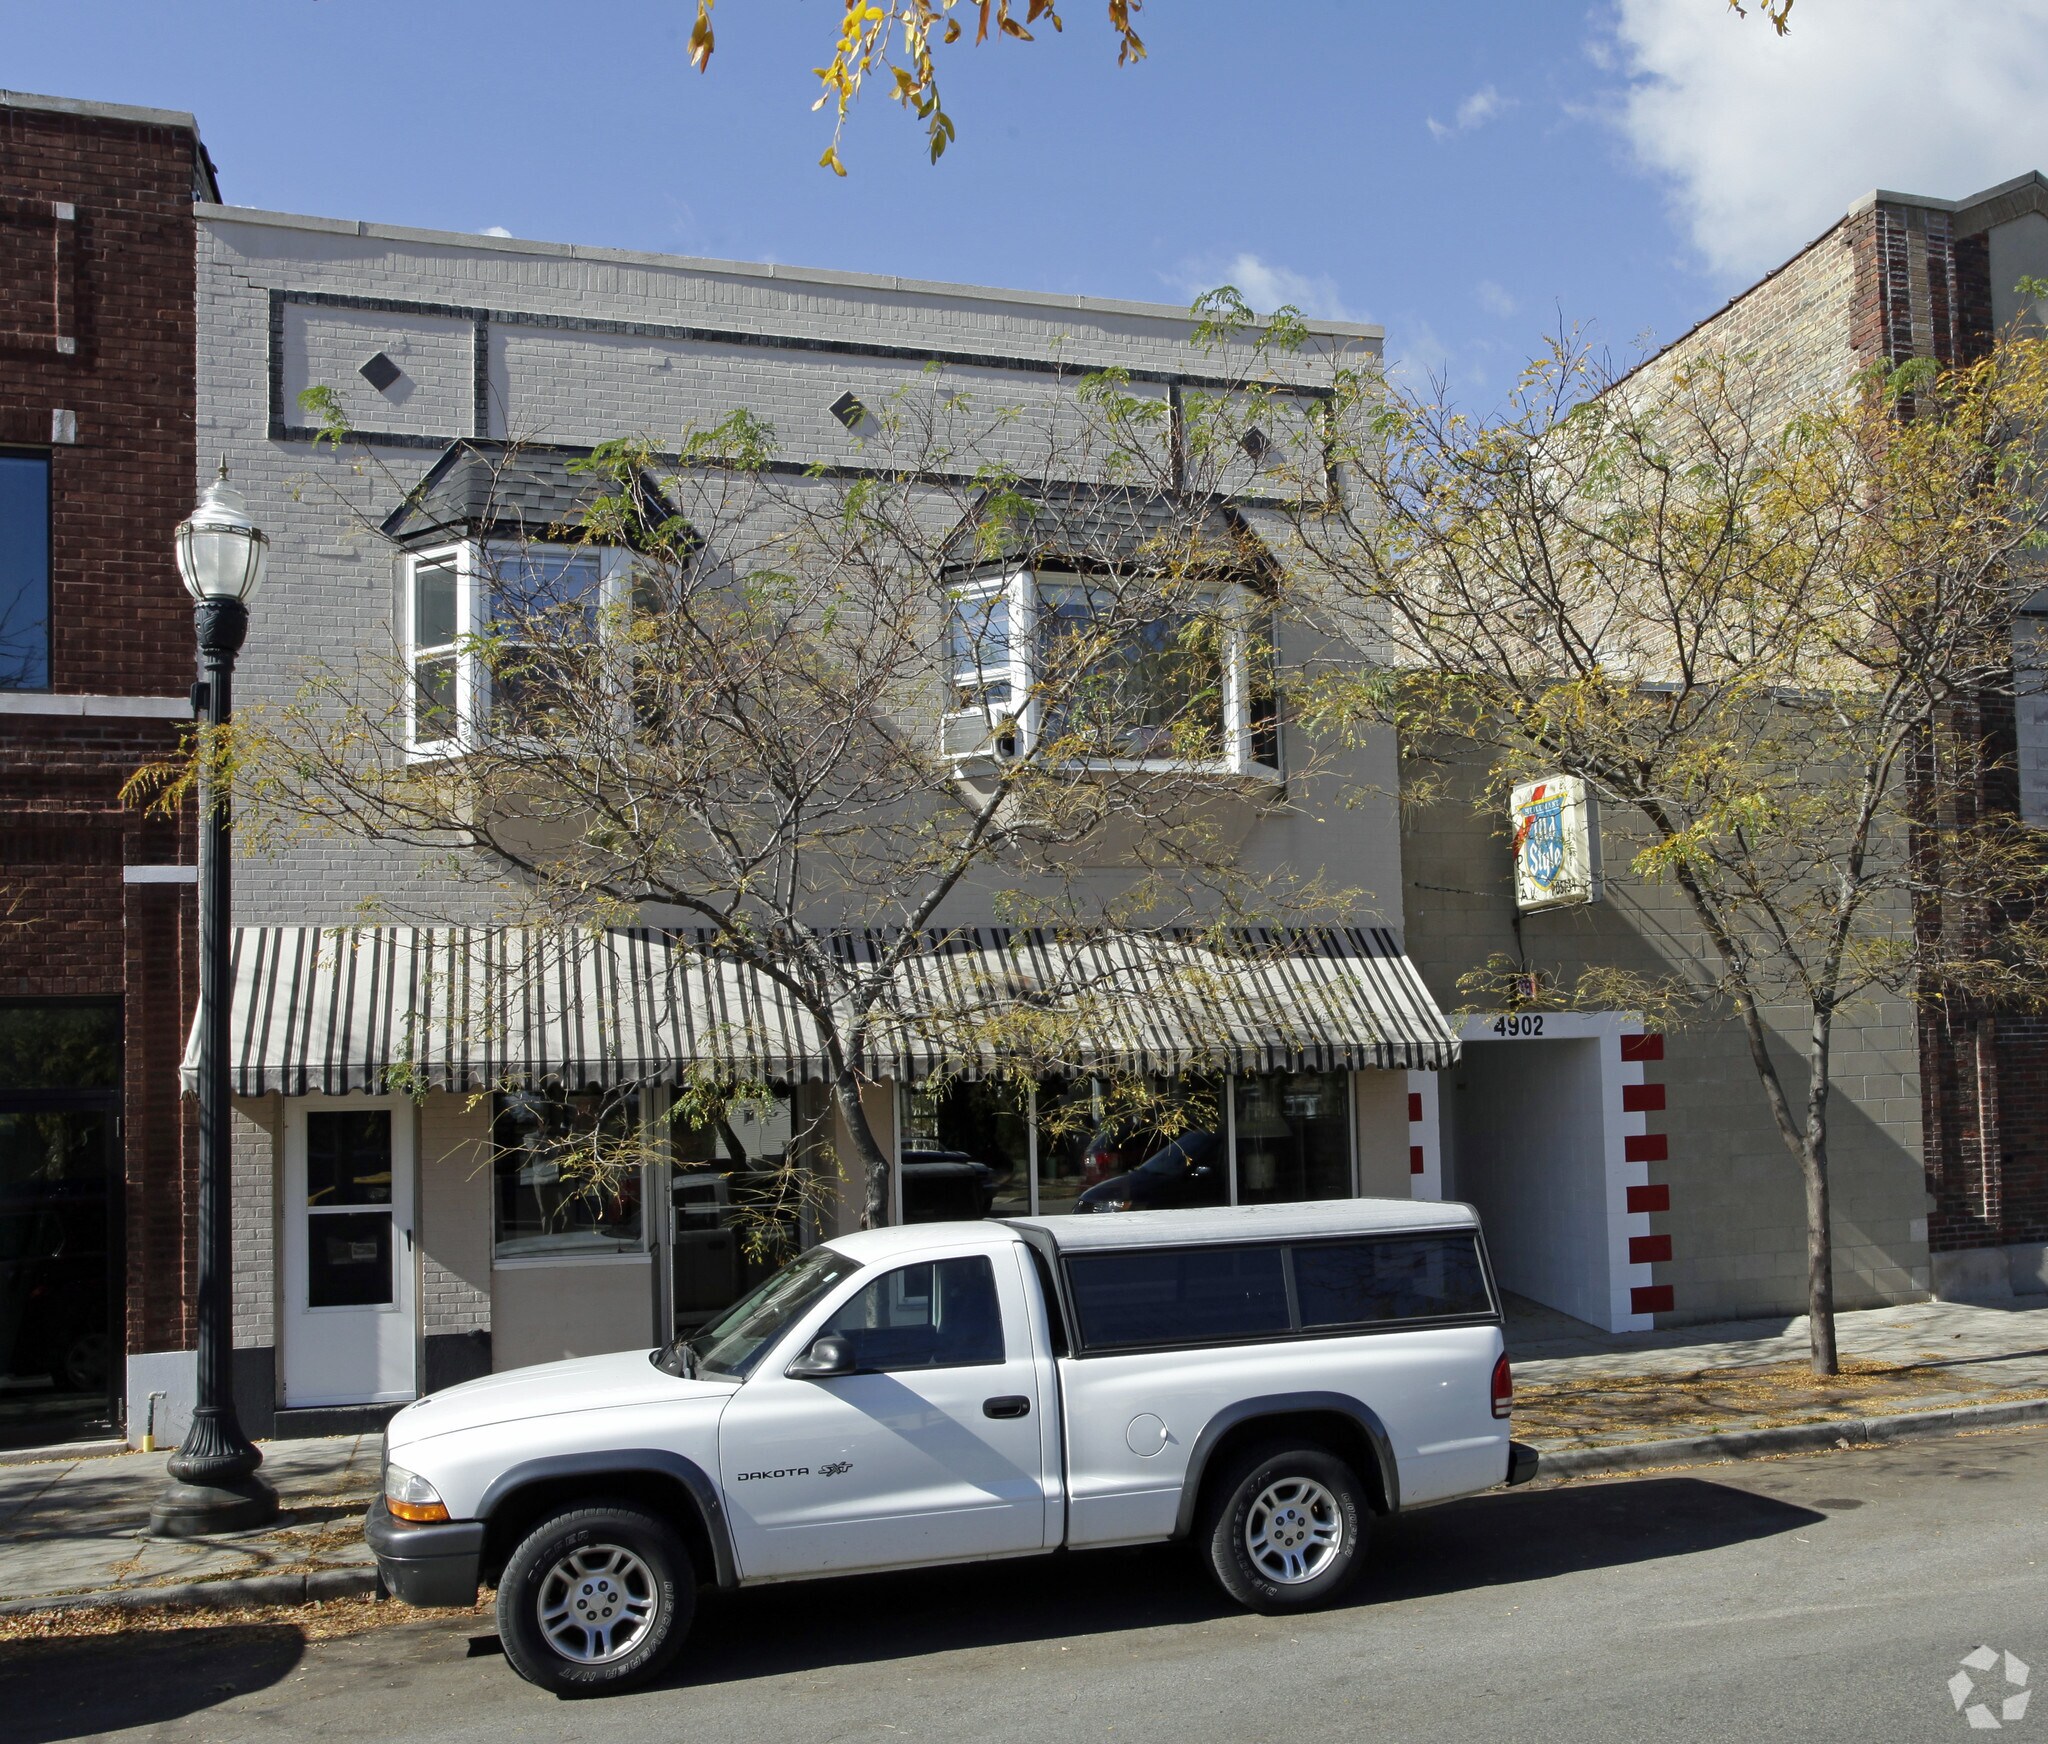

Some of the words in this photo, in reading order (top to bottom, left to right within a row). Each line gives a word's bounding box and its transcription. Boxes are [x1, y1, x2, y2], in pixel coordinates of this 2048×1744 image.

[1529, 842, 1563, 877] Style
[1494, 1014, 1544, 1036] 4902
[737, 1467, 810, 1481] DAKOTA
[818, 1461, 853, 1477] SXT
[1341, 1492, 1358, 1558] COOPER
[527, 1529, 590, 1584] COOPER
[604, 1581, 674, 1680] DISCOVERER
[558, 1667, 597, 1682] H/T
